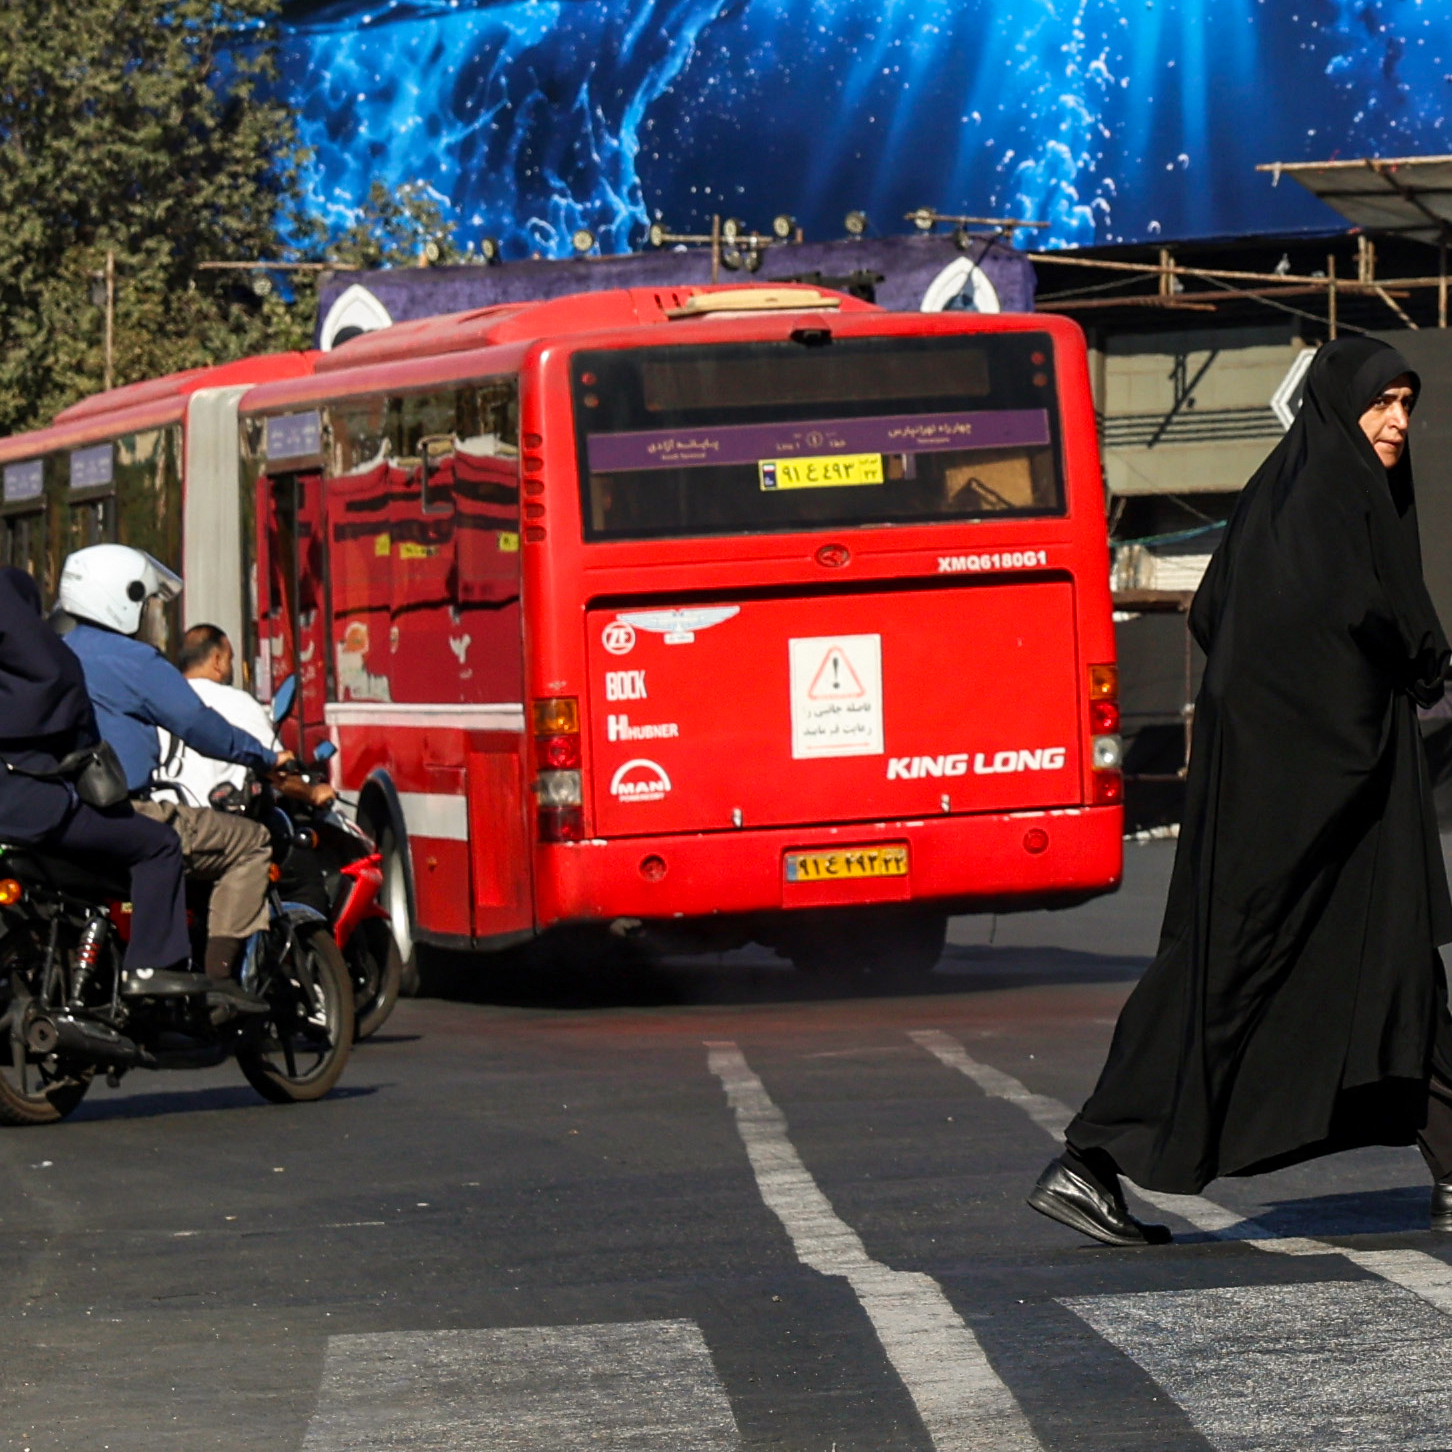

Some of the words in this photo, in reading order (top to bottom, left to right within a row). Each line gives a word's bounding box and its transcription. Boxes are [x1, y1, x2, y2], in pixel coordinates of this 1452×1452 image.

[937, 551, 1047, 573] XMQ6180G1
[887, 753, 969, 780] KING
[973, 747, 1066, 775] LONG
[618, 780, 665, 795] MAN
